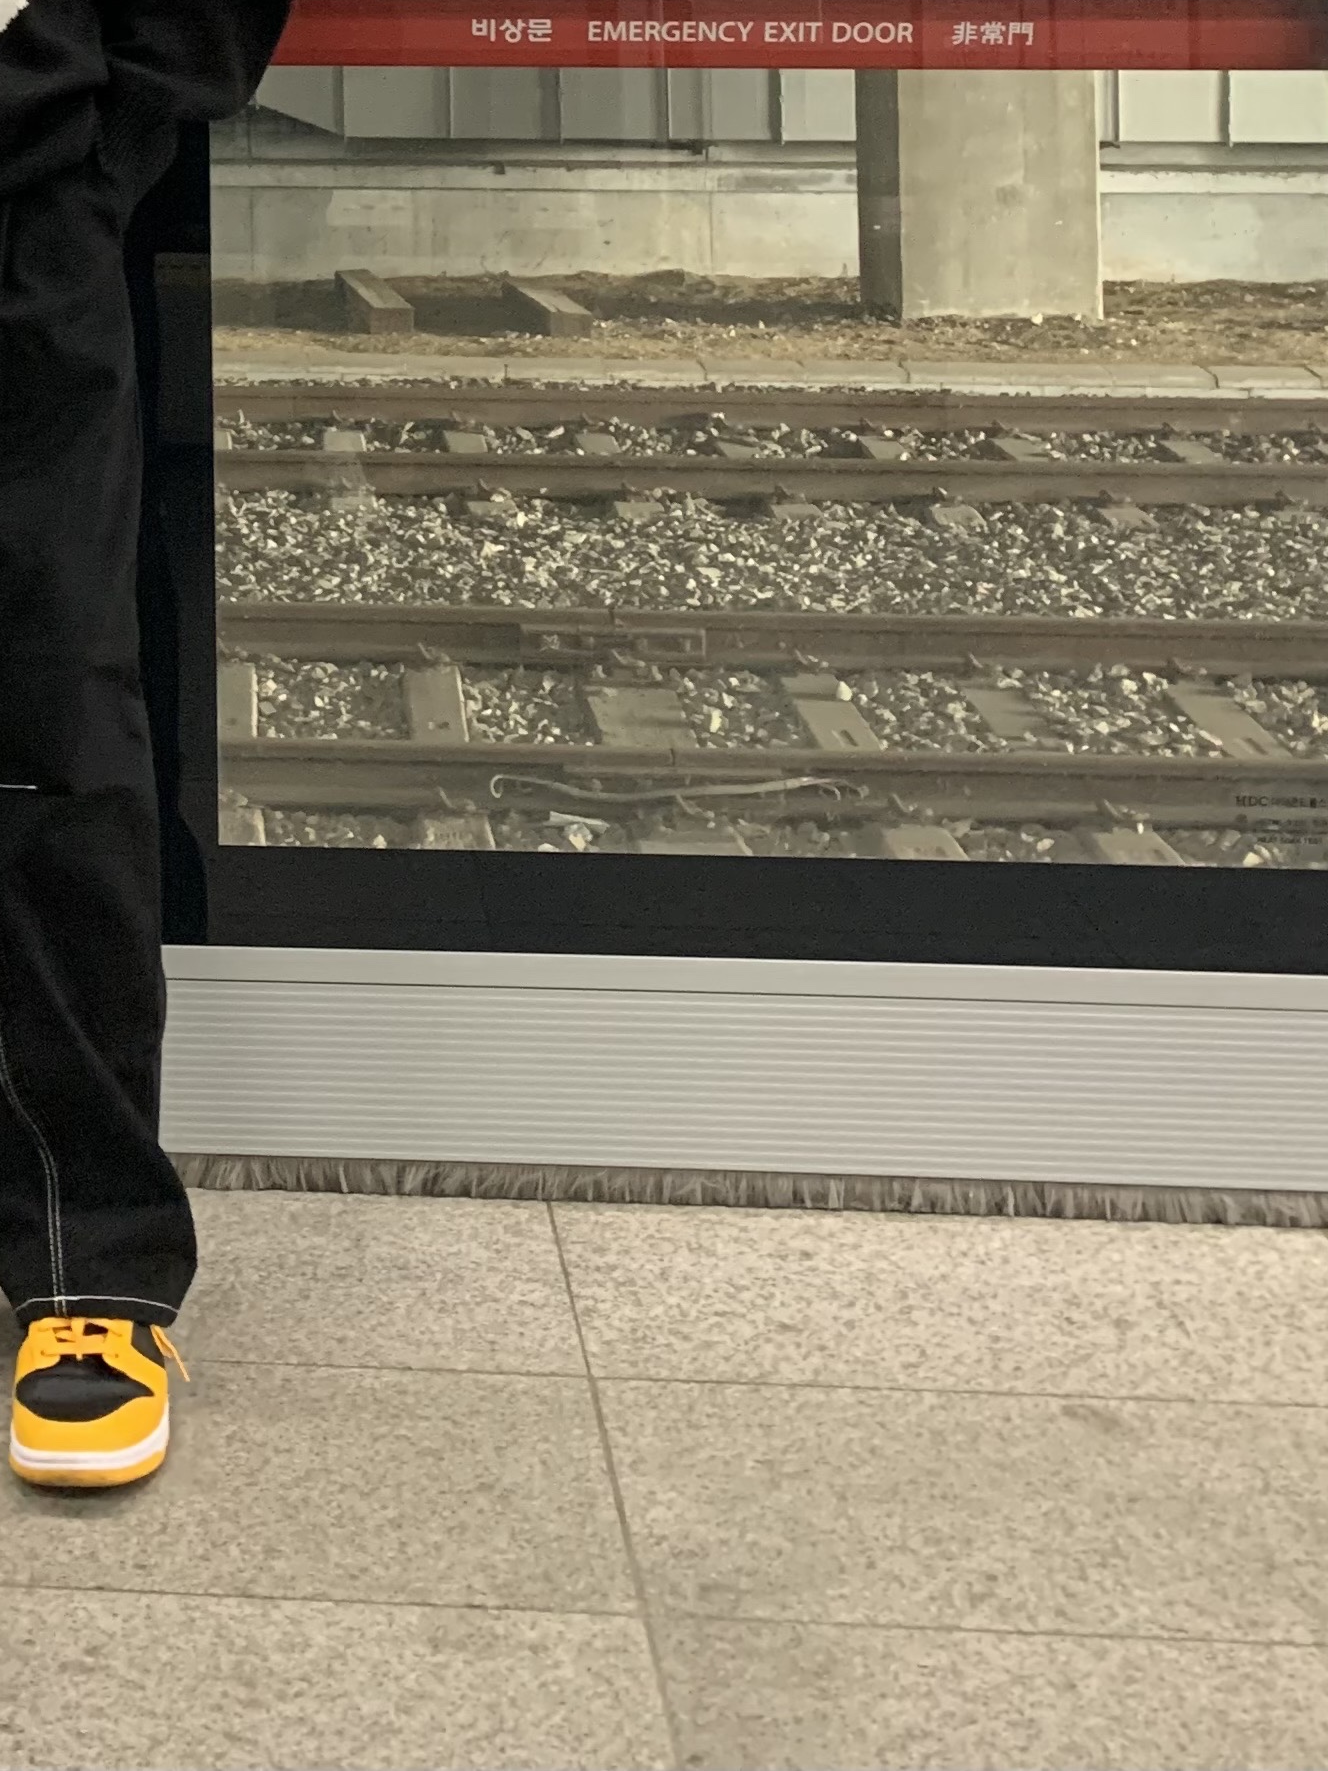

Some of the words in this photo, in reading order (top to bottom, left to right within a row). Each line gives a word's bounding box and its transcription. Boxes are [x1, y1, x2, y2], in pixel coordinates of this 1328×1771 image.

[471, 18, 553, 42] 비상문
[588, 21, 753, 43] EMERGENCY
[764, 21, 821, 43] EXIT
[832, 21, 913, 43] DOOR
[952, 21, 1034, 46] 非常門
